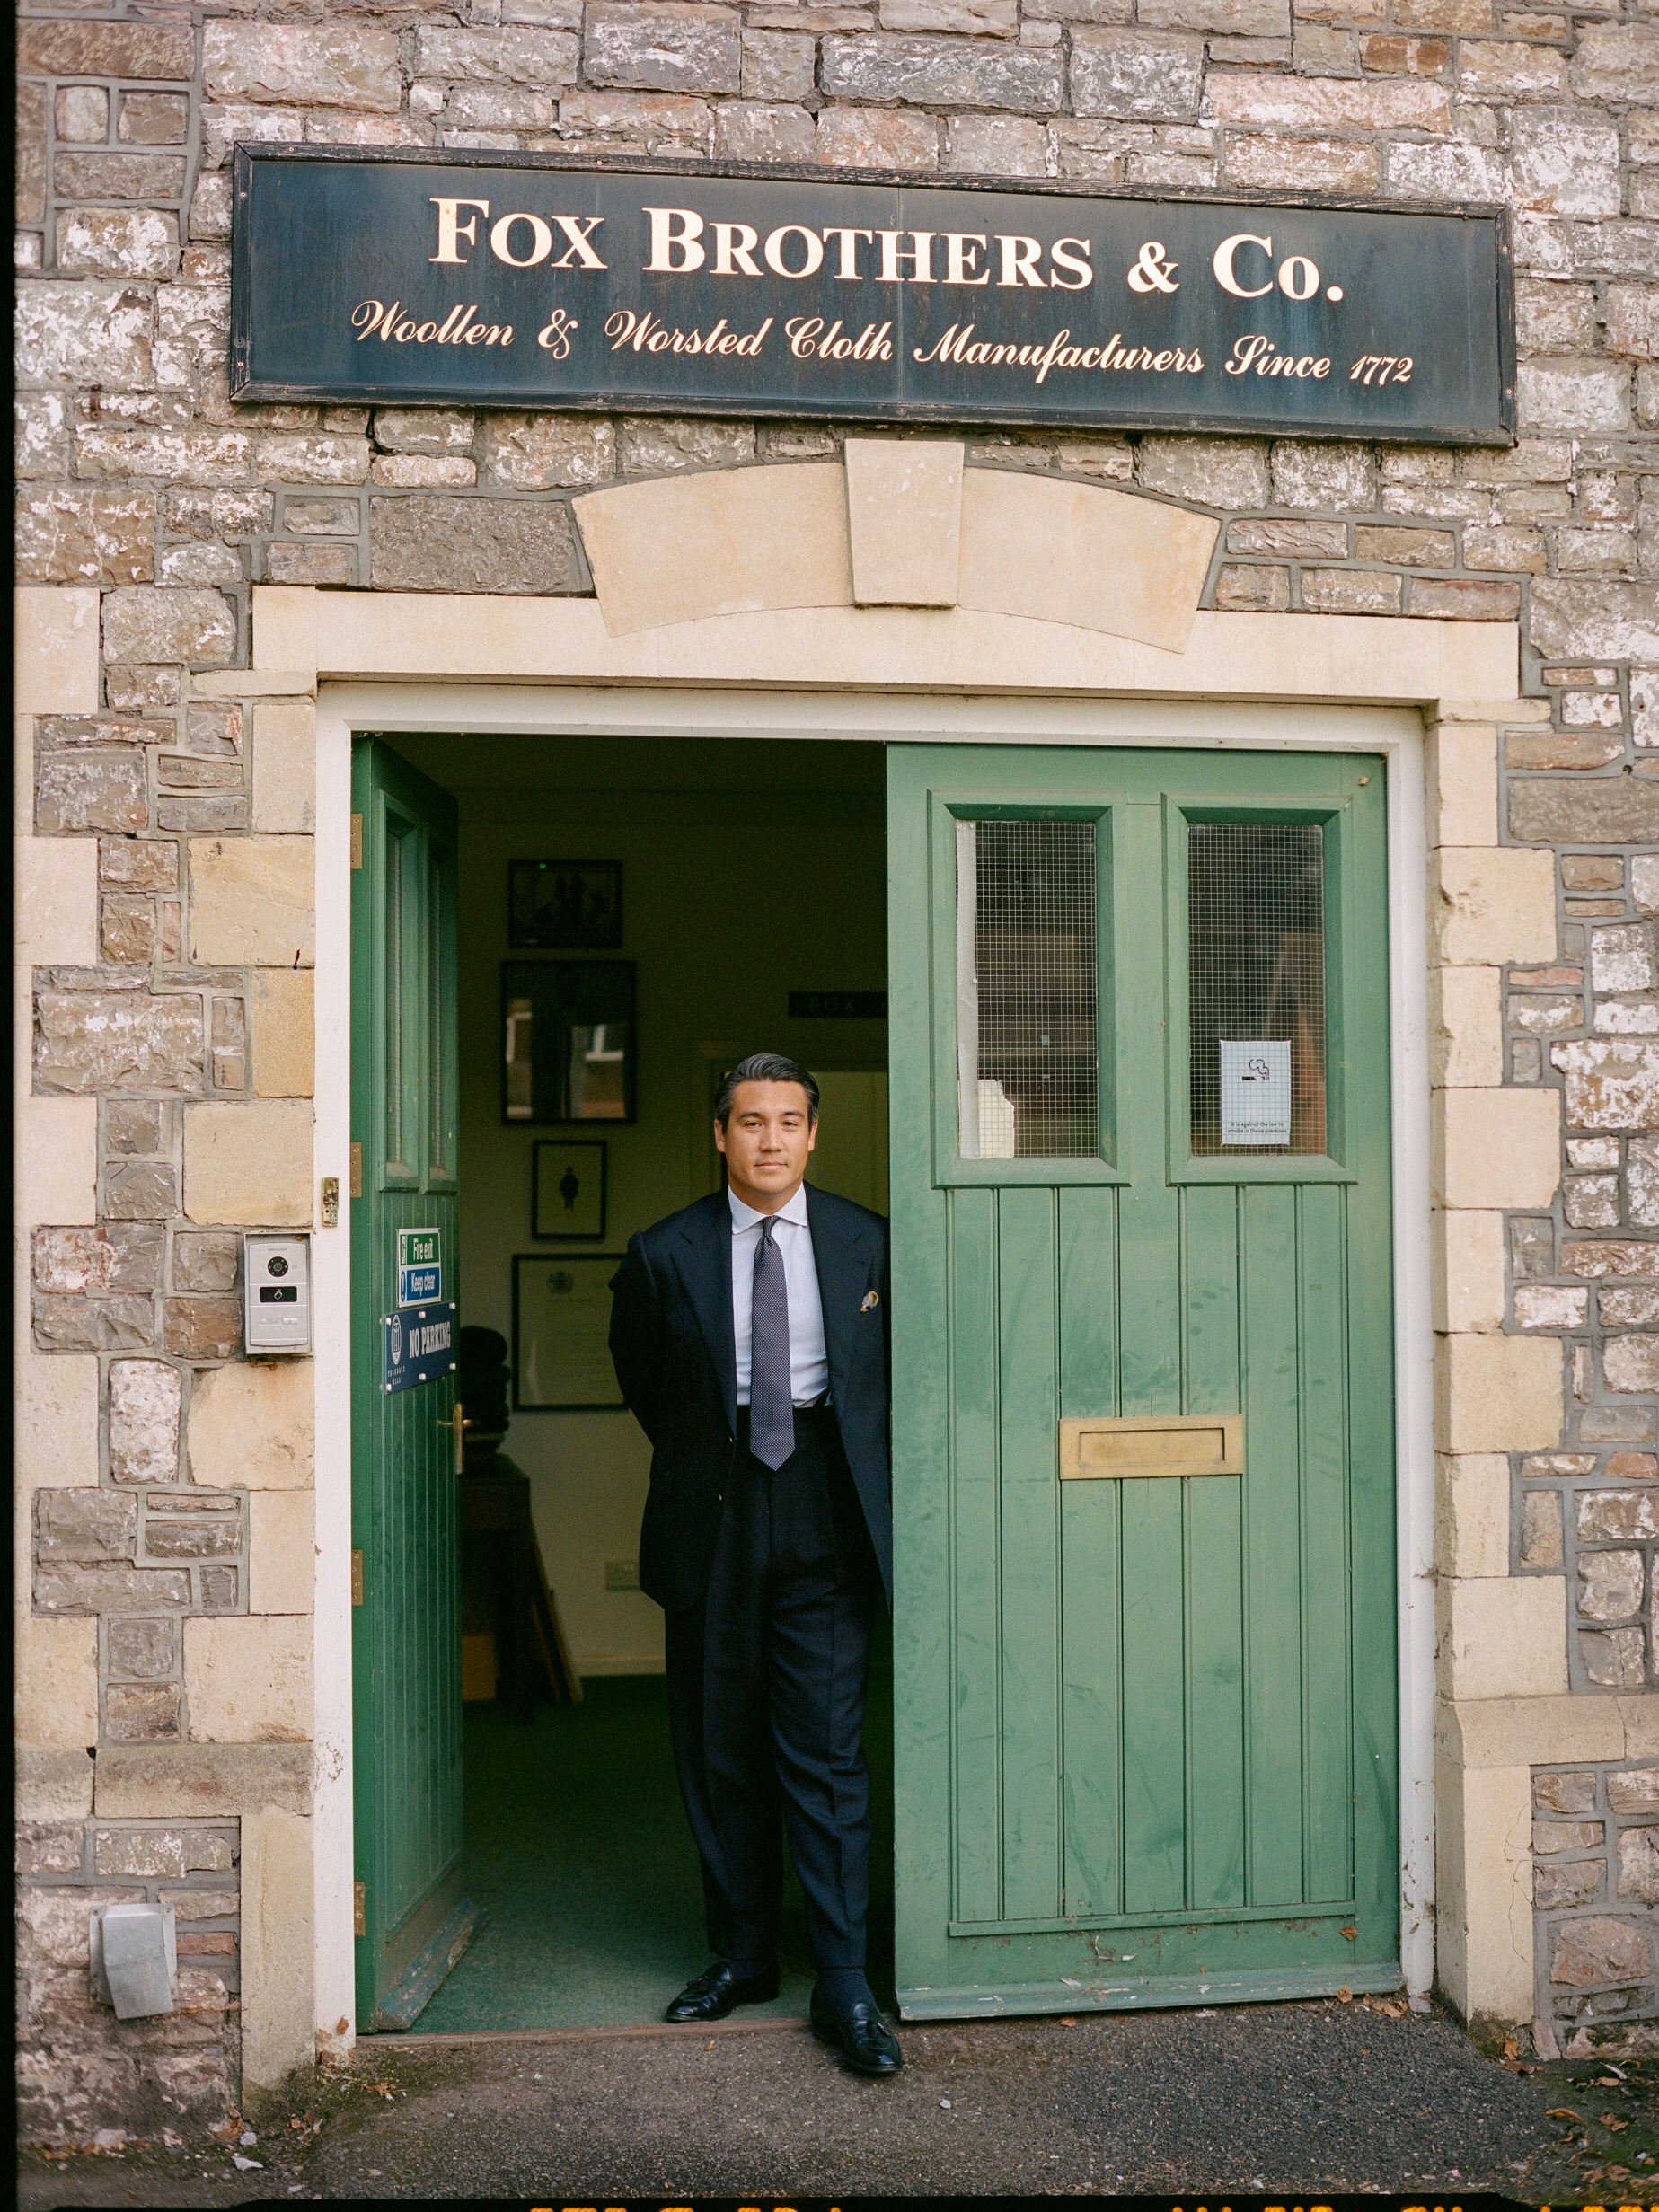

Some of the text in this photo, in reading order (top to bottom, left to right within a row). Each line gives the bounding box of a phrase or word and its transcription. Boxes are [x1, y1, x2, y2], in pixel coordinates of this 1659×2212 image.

[641, 207, 1093, 290] BROTHERS
[1126, 241, 1180, 294] &
[351, 300, 1413, 385] Woollen & Worsted Cloth Manufacturers Since 1772
[413, 1238, 433, 1260] Fire exit
[411, 1269, 435, 1296] Keep clear
[410, 1321, 450, 1358] NO PARKING
